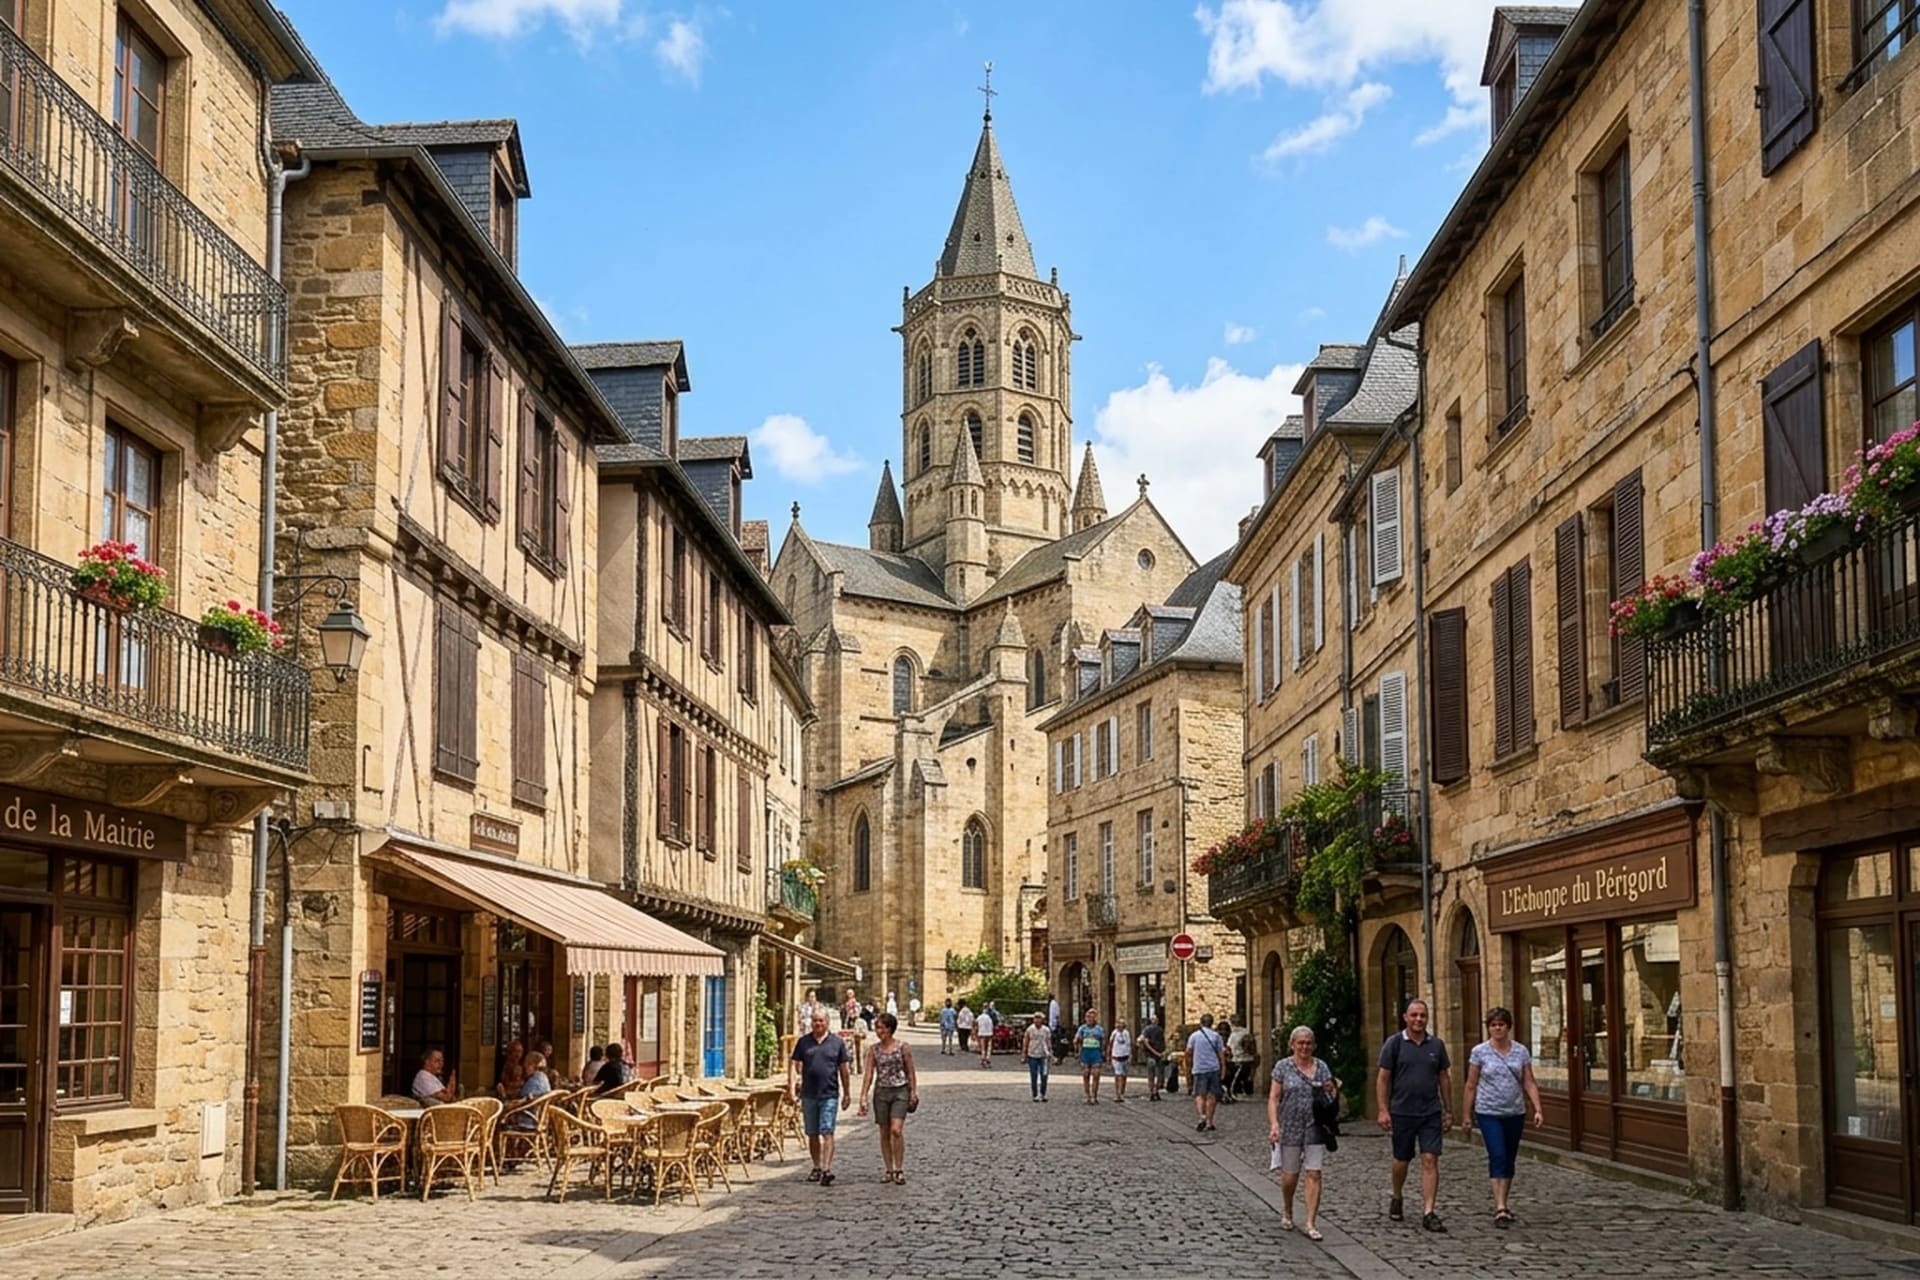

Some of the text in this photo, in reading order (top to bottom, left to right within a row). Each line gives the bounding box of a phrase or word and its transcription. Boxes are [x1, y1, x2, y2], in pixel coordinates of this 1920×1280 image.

[4, 796, 155, 850] de la Mairie
[1501, 856, 1668, 917] L'Echoppe du Périgord
